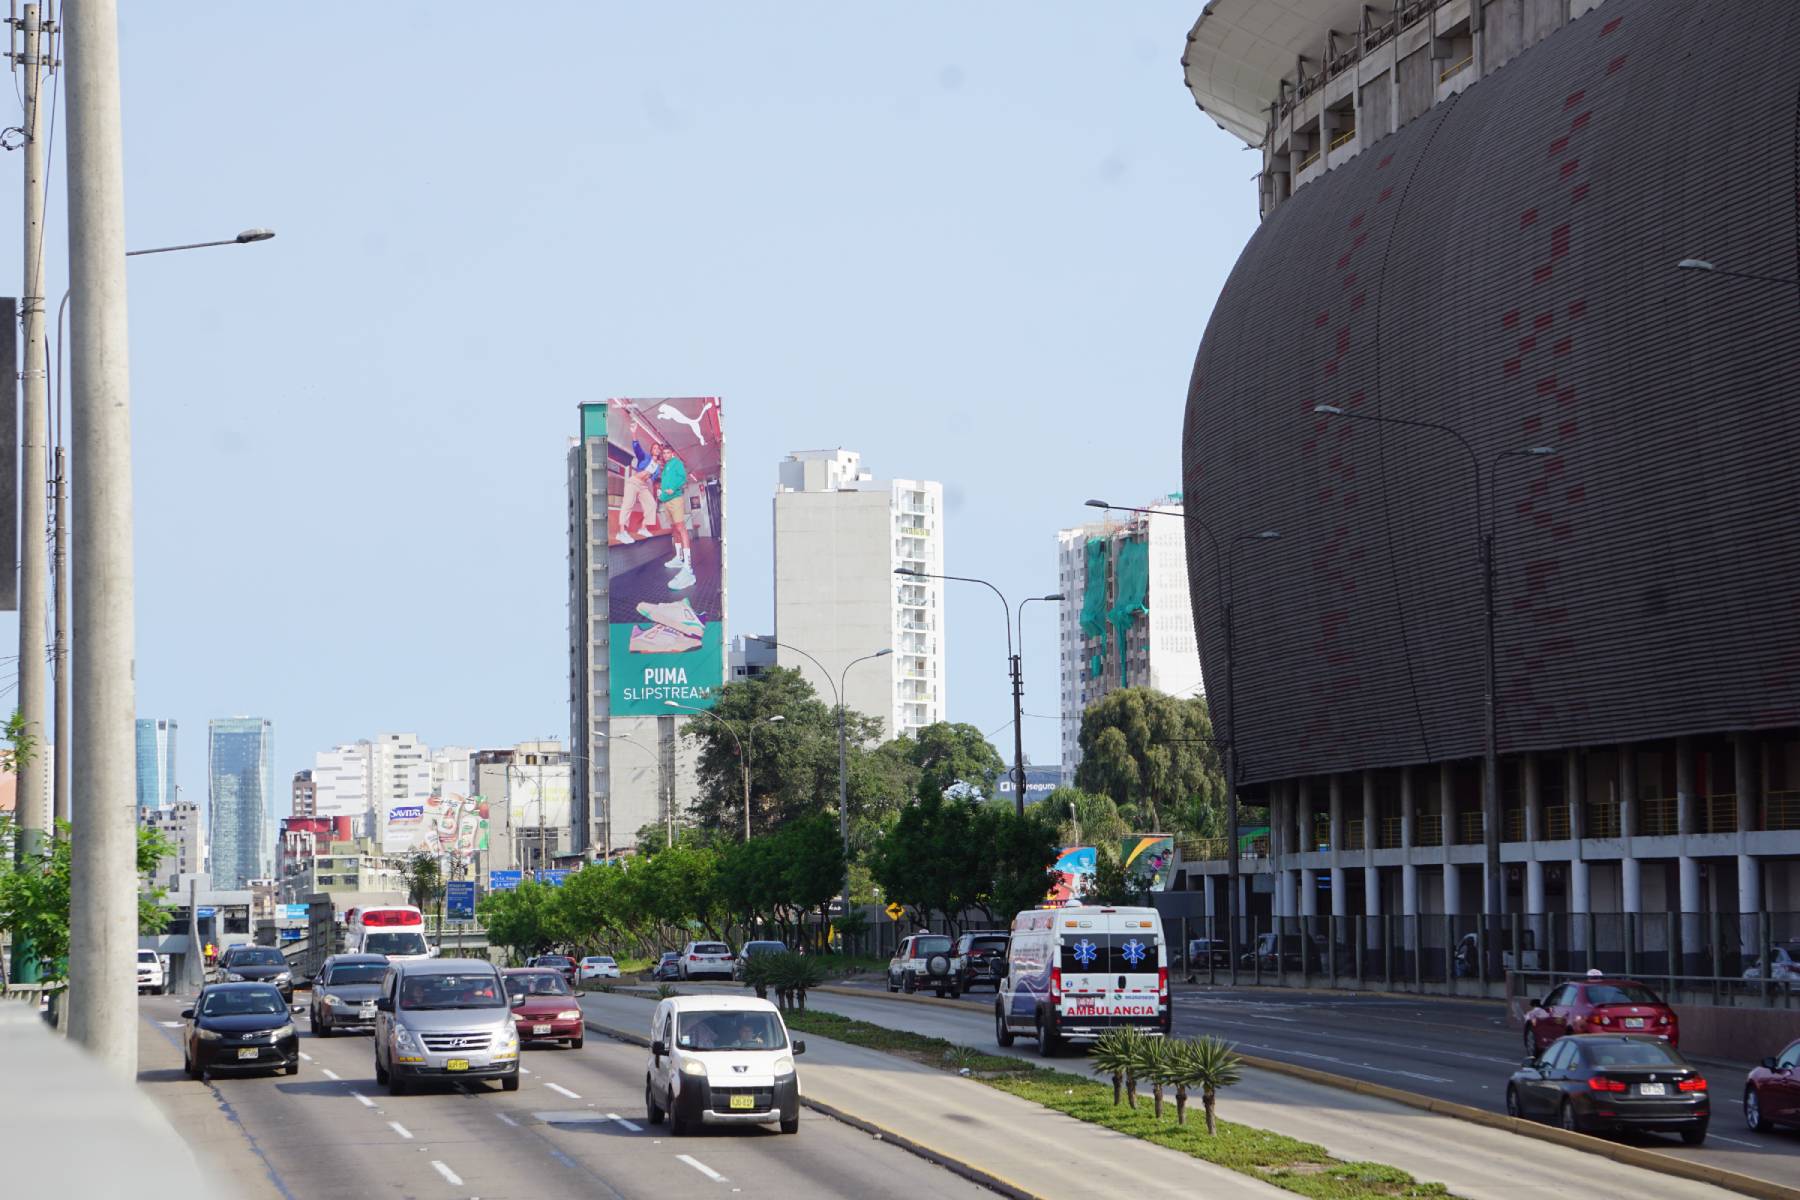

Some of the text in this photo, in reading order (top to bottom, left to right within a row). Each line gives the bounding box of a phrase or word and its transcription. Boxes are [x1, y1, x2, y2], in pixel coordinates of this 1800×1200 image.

[644, 667, 688, 685] PUMA
[623, 686, 710, 700] SLIPSTREAM
[1067, 1005, 1154, 1016] AMBULANCIA
